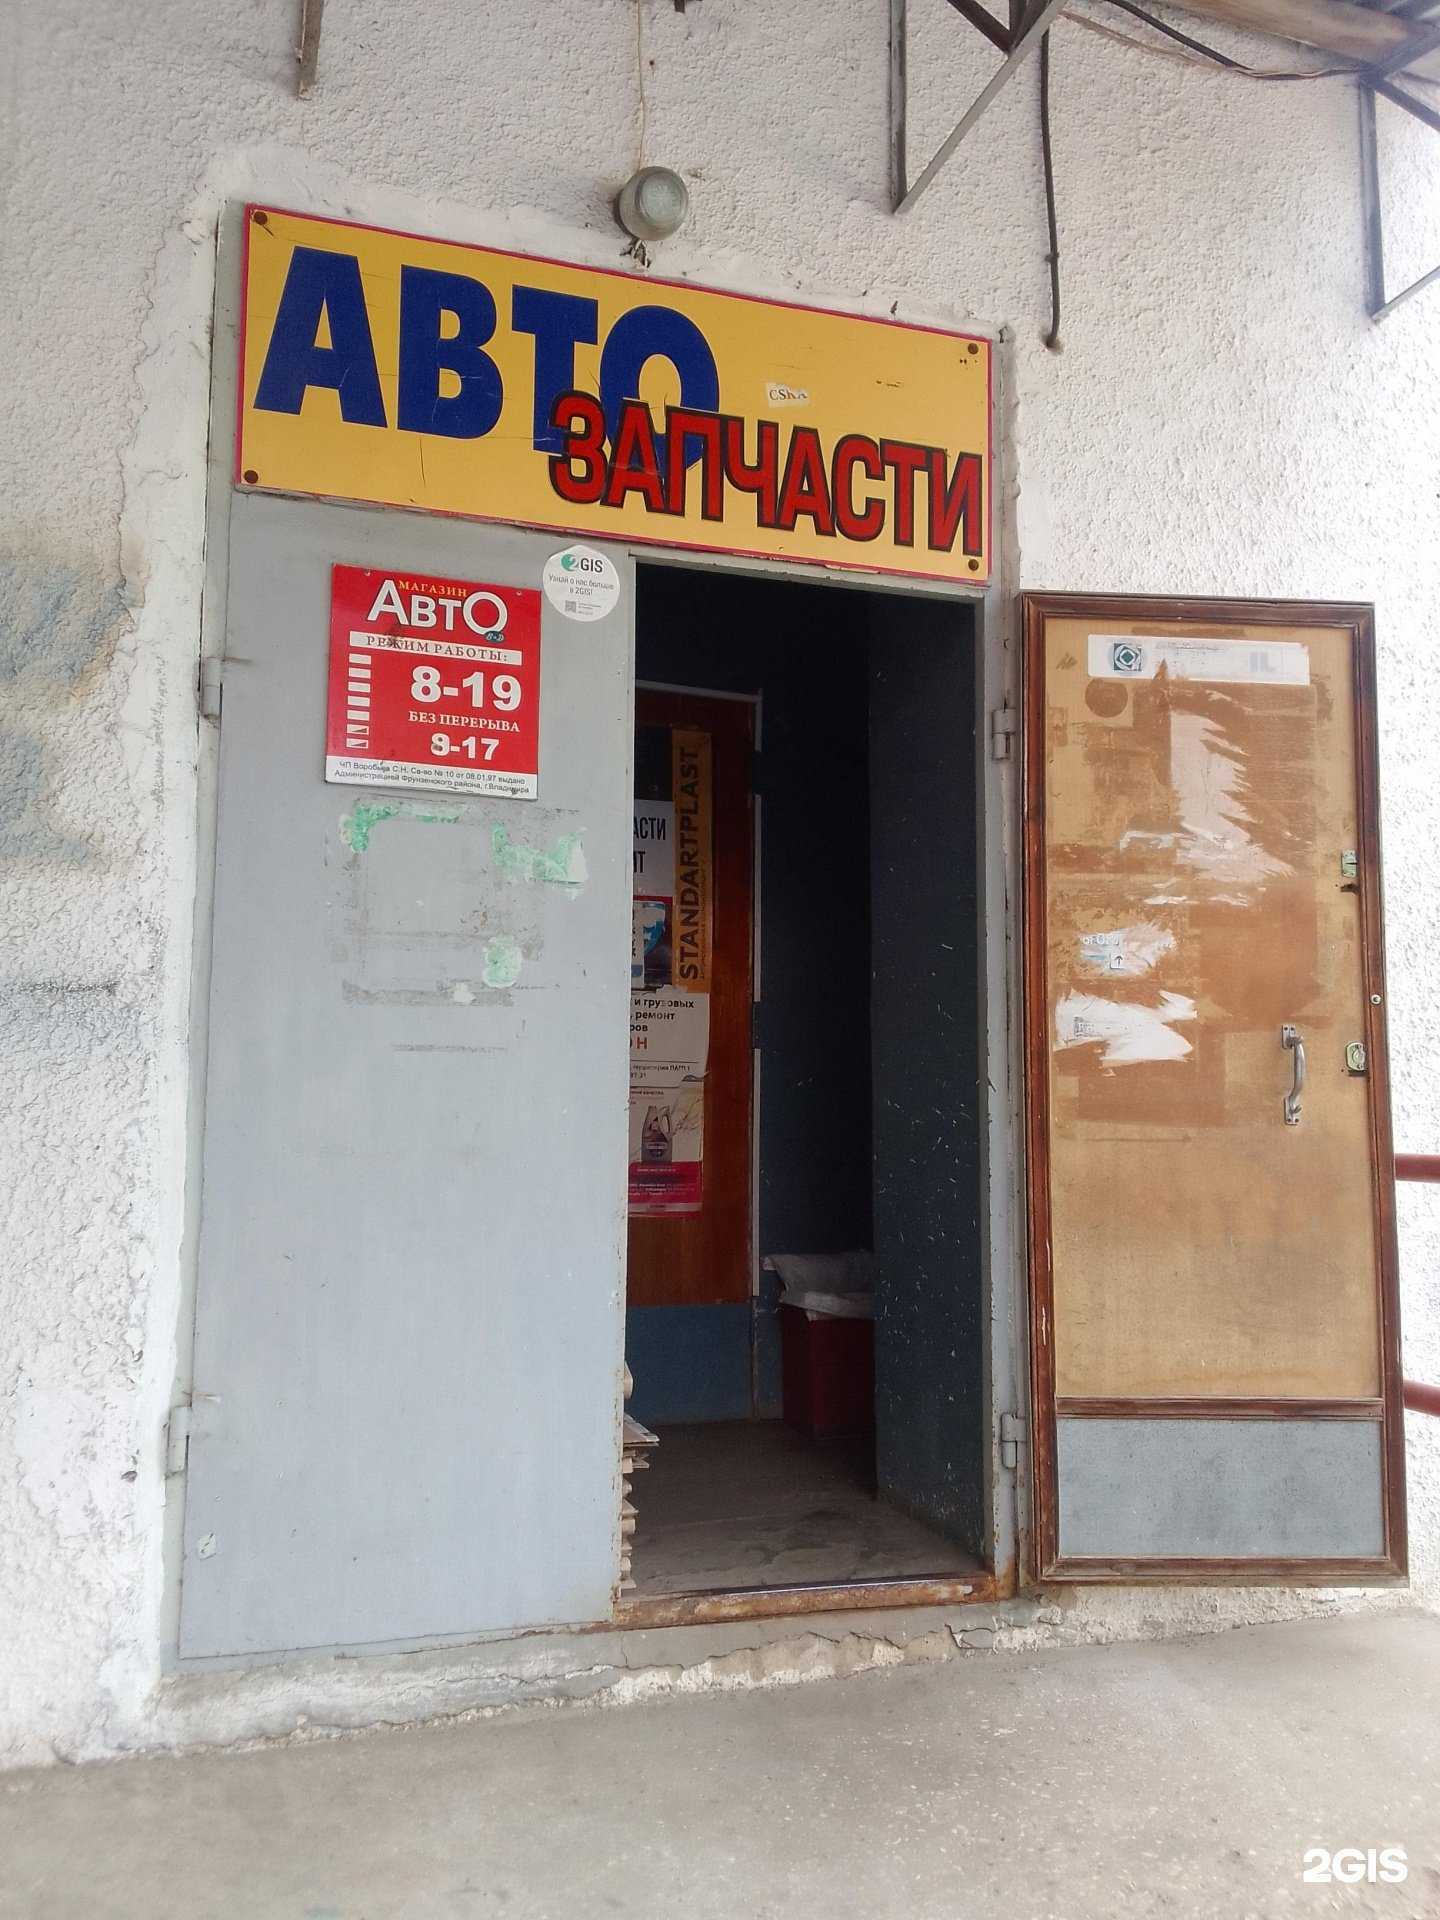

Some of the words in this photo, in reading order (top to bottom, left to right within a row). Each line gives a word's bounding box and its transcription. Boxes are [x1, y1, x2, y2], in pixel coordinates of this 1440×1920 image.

[252, 245, 720, 472] АВТО
[549, 389, 984, 557] ЗАПЧАСТИ
[398, 580, 468, 598] МАГАЗИН
[366, 635, 430, 653] РЕЖИМ
[434, 642, 508, 662] РАБОТЫ:
[410, 665, 522, 711] 8-19
[408, 710, 436, 725] БЕЗ
[439, 713, 521, 733] ПЕРЕРЫВА
[680, 748, 699, 980] STANDARTPLAST
